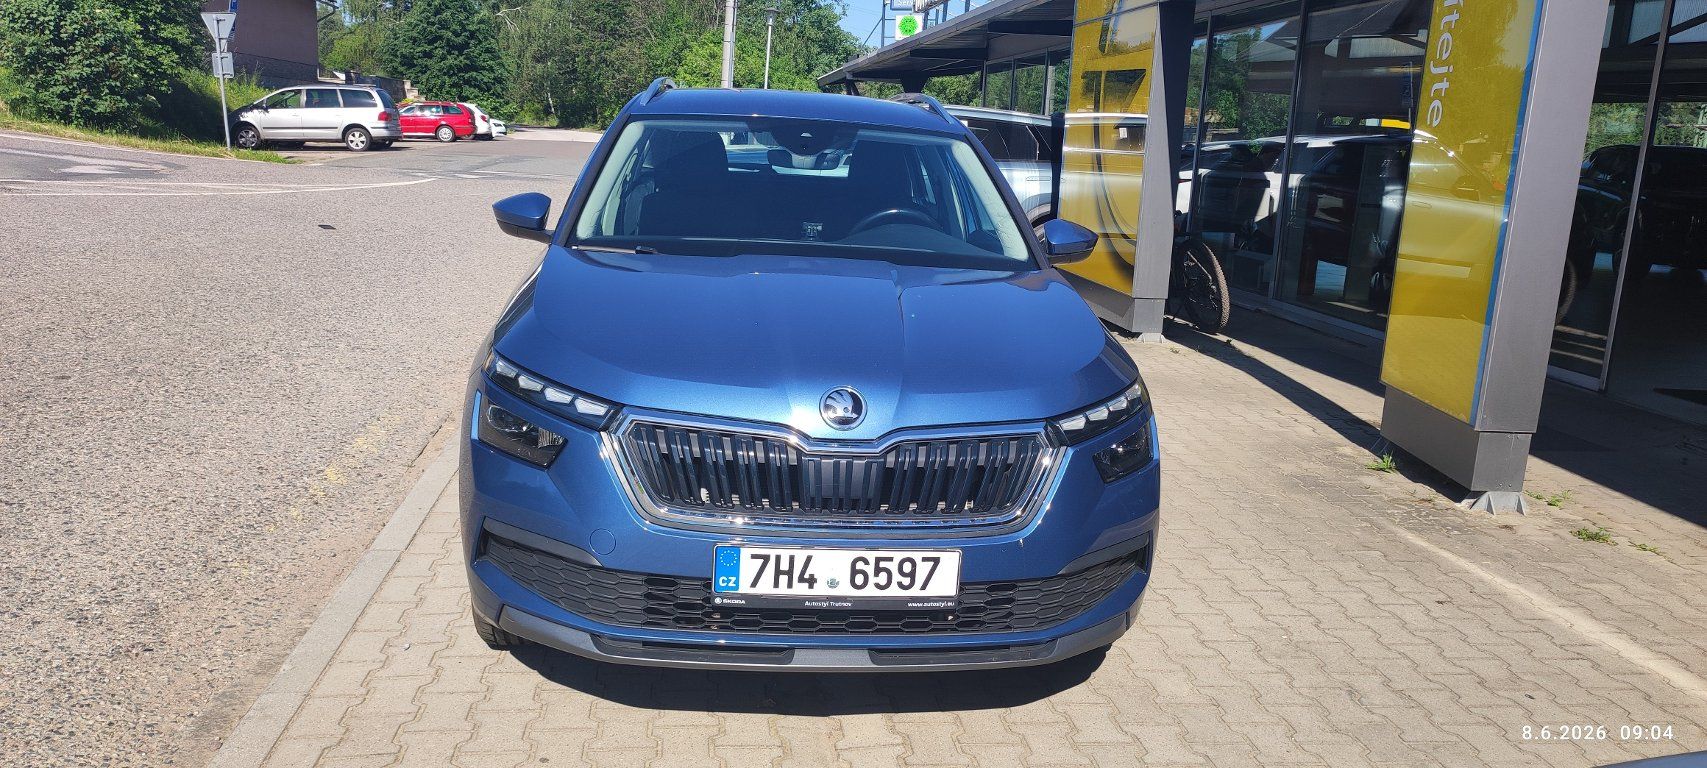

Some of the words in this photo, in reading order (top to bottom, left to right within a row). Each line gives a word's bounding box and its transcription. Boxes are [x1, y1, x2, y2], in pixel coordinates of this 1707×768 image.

[719, 576, 736, 587] CZ
[750, 553, 817, 589] 7H4
[850, 556, 941, 591] 6597
